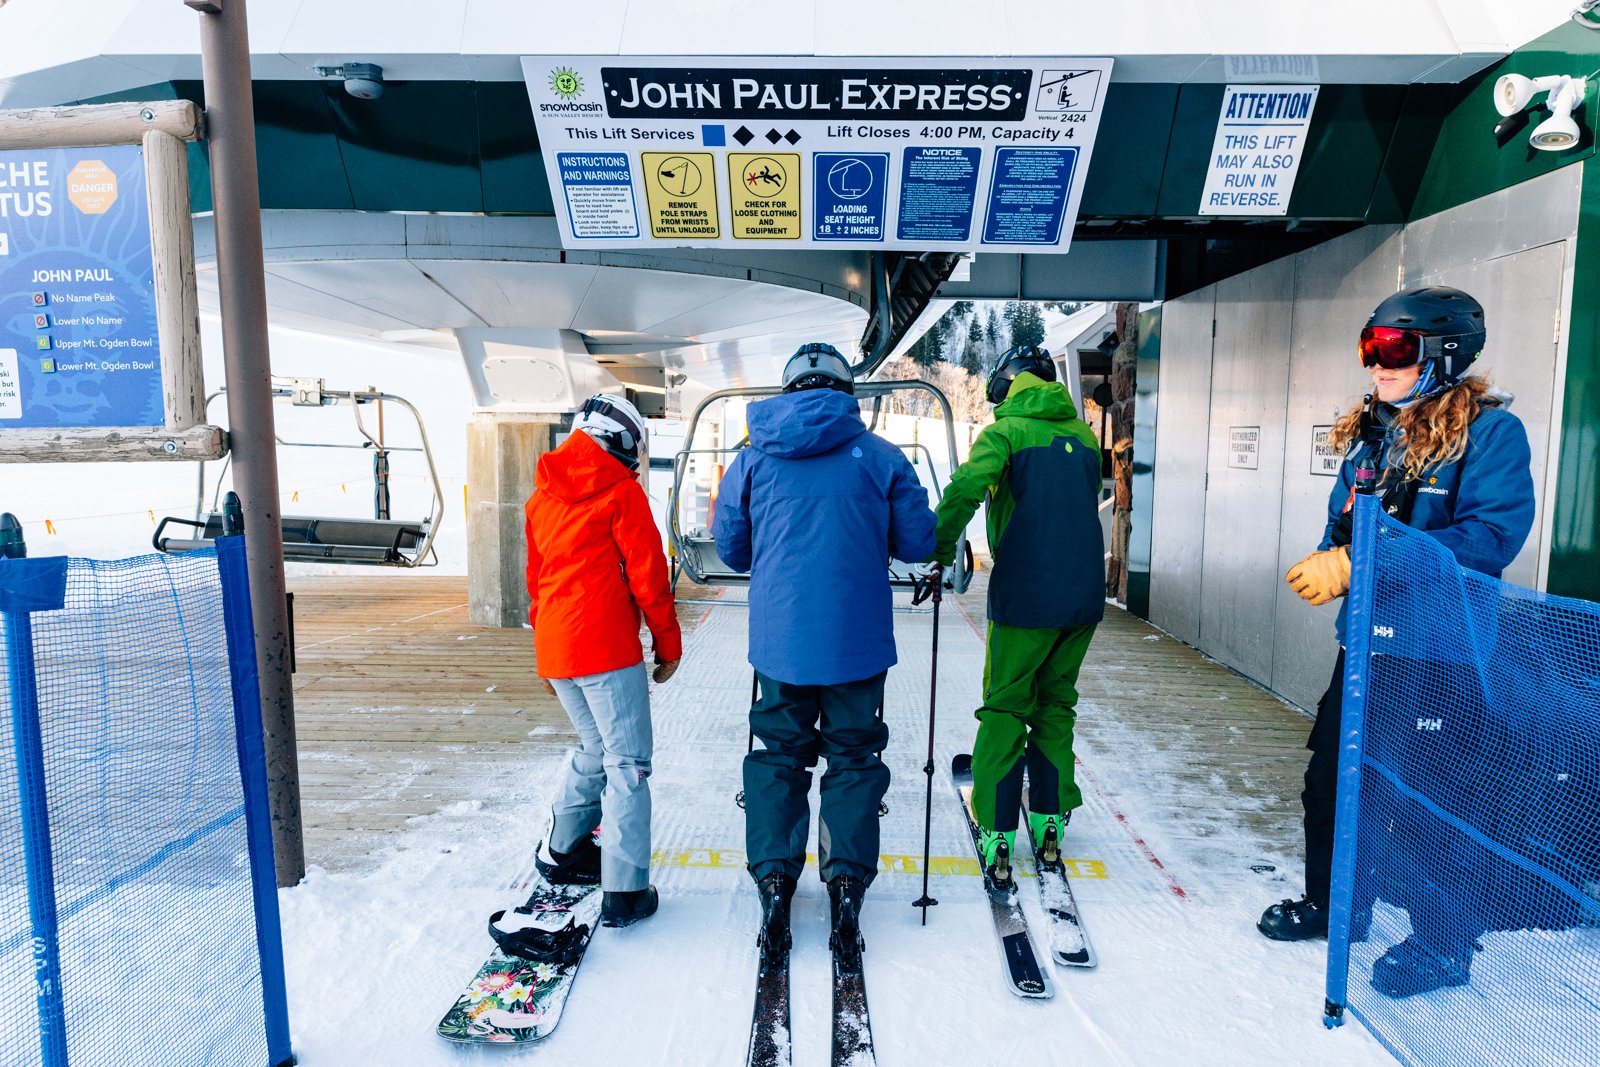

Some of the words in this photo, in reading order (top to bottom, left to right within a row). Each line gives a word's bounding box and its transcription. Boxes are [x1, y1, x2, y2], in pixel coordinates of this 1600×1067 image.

[621, 78, 722, 109] JOHN
[732, 78, 830, 110] PAUL
[841, 78, 1012, 111] EXPRESS
[540, 102, 602, 111] snowbasin
[1226, 93, 1312, 118] ATTENTION
[1060, 114, 1086, 123] 2424
[565, 127, 598, 140] This
[603, 128, 627, 140] Lift
[631, 128, 695, 140] Services
[827, 126, 852, 138] Lift
[857, 126, 910, 138] Closes
[920, 126, 952, 138] 4:00
[957, 127, 986, 140] PM,
[992, 126, 1060, 141] Capacity
[1065, 128, 1074, 139] 4
[1225, 136, 1258, 149] THIS
[1264, 136, 1297, 149] LIFT
[562, 157, 625, 166] INSTRUCTIONS
[1216, 155, 1248, 168] MAY
[1252, 155, 1293, 168] ALSO
[564, 171, 581, 180] AND
[583, 171, 629, 180] WARNINGS
[1224, 174, 1256, 187] RUN
[1261, 174, 1277, 187] IN
[72, 183, 114, 192] DANGER
[1210, 193, 1280, 206] REVERSE.
[833, 205, 867, 213] LOADING
[846, 216, 875, 224] HEIGHT
[851, 226, 879, 234] INCHES
[32, 270, 72, 282] JOHN
[75, 269, 113, 282] PAUL
[52, 294, 64, 302] No
[67, 294, 92, 302] Name
[94, 293, 115, 302] Peak
[54, 317, 80, 325] Lower
[82, 317, 95, 325] No
[97, 317, 122, 325] Name
[55, 339, 81, 350] Upper
[84, 339, 97, 348] Mt.
[100, 338, 128, 350] Ogden
[131, 338, 152, 347] Bowl
[57, 362, 83, 370] Lower
[85, 362, 98, 370] Mt.
[101, 361, 130, 372] Ogden
[132, 361, 154, 370] Bowl
[1232, 432, 1257, 441] AUTHORIZED
[1232, 443, 1255, 453] PERSONNEL
[1238, 455, 1248, 463] ONLY
[1323, 459, 1337, 469] ONLY
